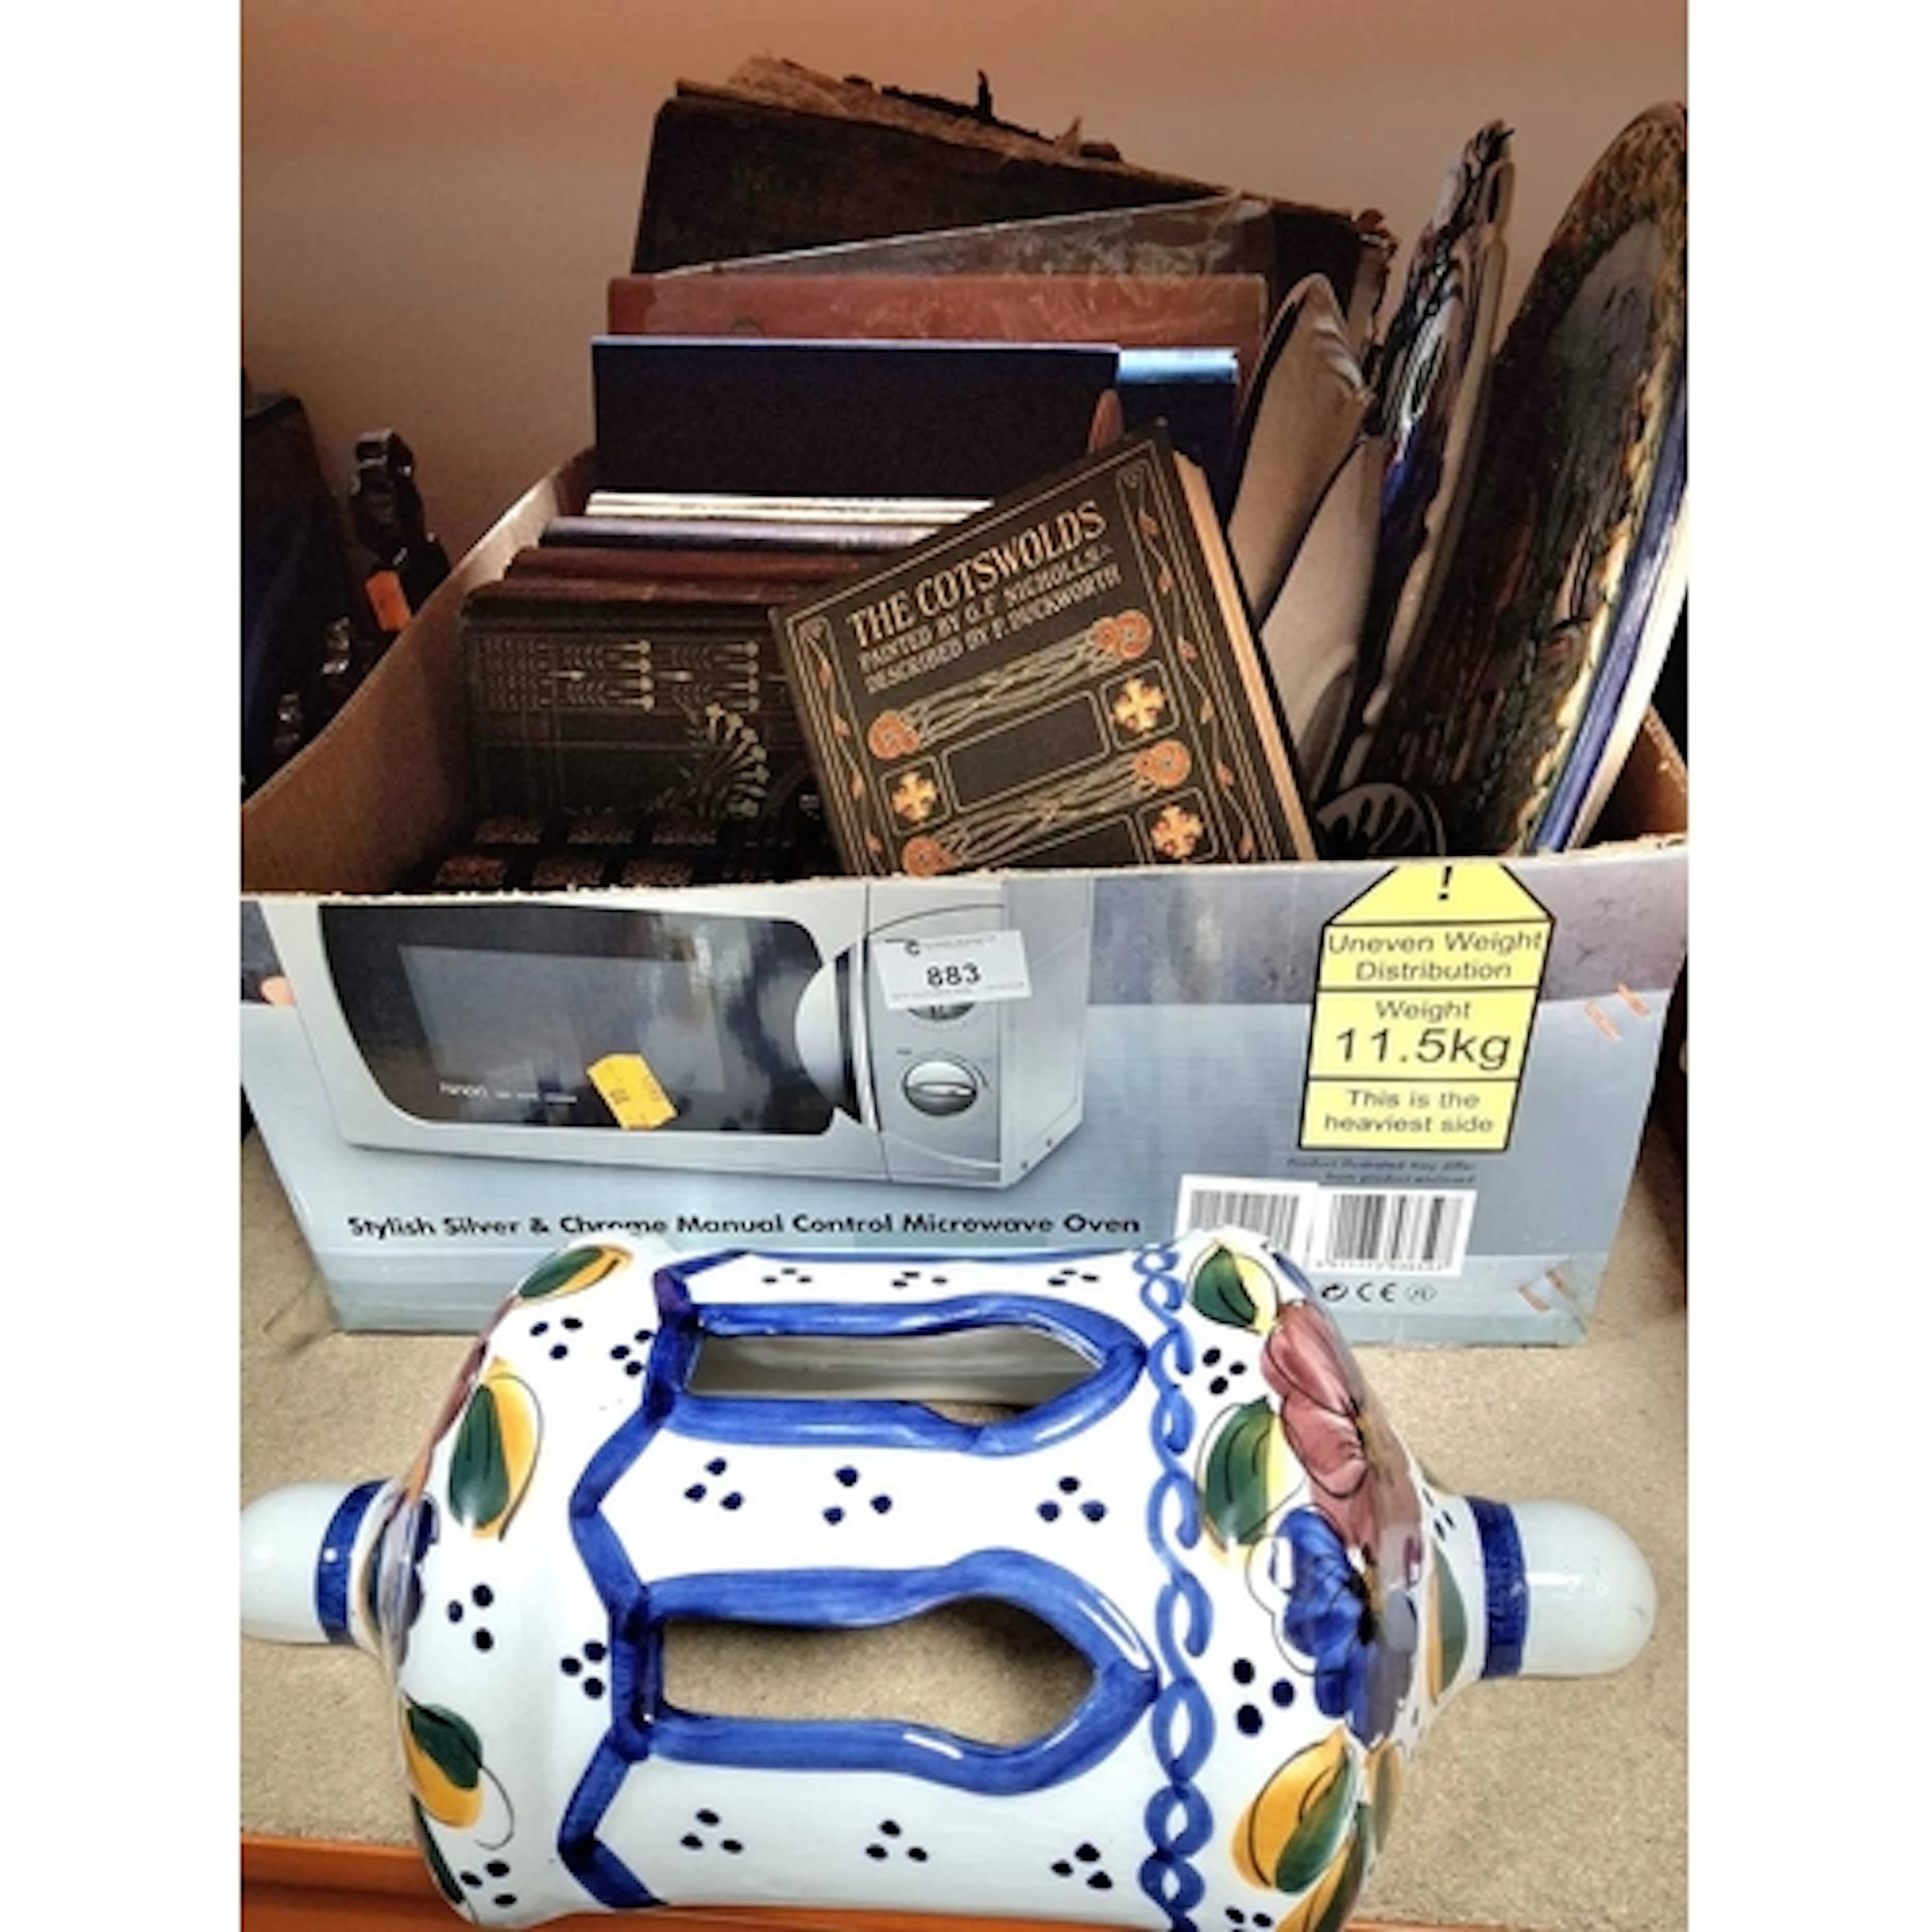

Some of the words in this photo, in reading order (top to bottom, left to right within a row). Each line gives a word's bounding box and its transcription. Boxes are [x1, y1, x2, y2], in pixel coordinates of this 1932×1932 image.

[846, 589, 917, 648] THE
[916, 500, 1106, 617] COTSWOLDS
[864, 637, 964, 694] DESCRIBED
[964, 626, 990, 652] BY
[1007, 563, 1122, 631] DUCKWORTH
[858, 624, 933, 674] PAINTED
[935, 610, 960, 637] BY
[1328, 934, 1434, 954] Uneven
[1444, 930, 1543, 955] Weight
[927, 962, 981, 986] 883
[1355, 961, 1511, 982] Distribution
[1375, 1000, 1472, 1023] Weight
[1337, 1027, 1510, 1071] 11.5kg
[1347, 1089, 1400, 1107] This
[1409, 1090, 1430, 1107] is
[1440, 1090, 1480, 1108] the
[1324, 1113, 1433, 1133] heaviest
[1440, 1115, 1493, 1133] side
[348, 1217, 437, 1240] Stylish
[443, 1217, 522, 1236] Silver
[529, 1217, 549, 1235] &
[677, 1214, 785, 1234] Manual
[792, 1214, 894, 1234] Control
[903, 1214, 1054, 1234] Microwave
[1064, 1214, 1141, 1234] Oven
